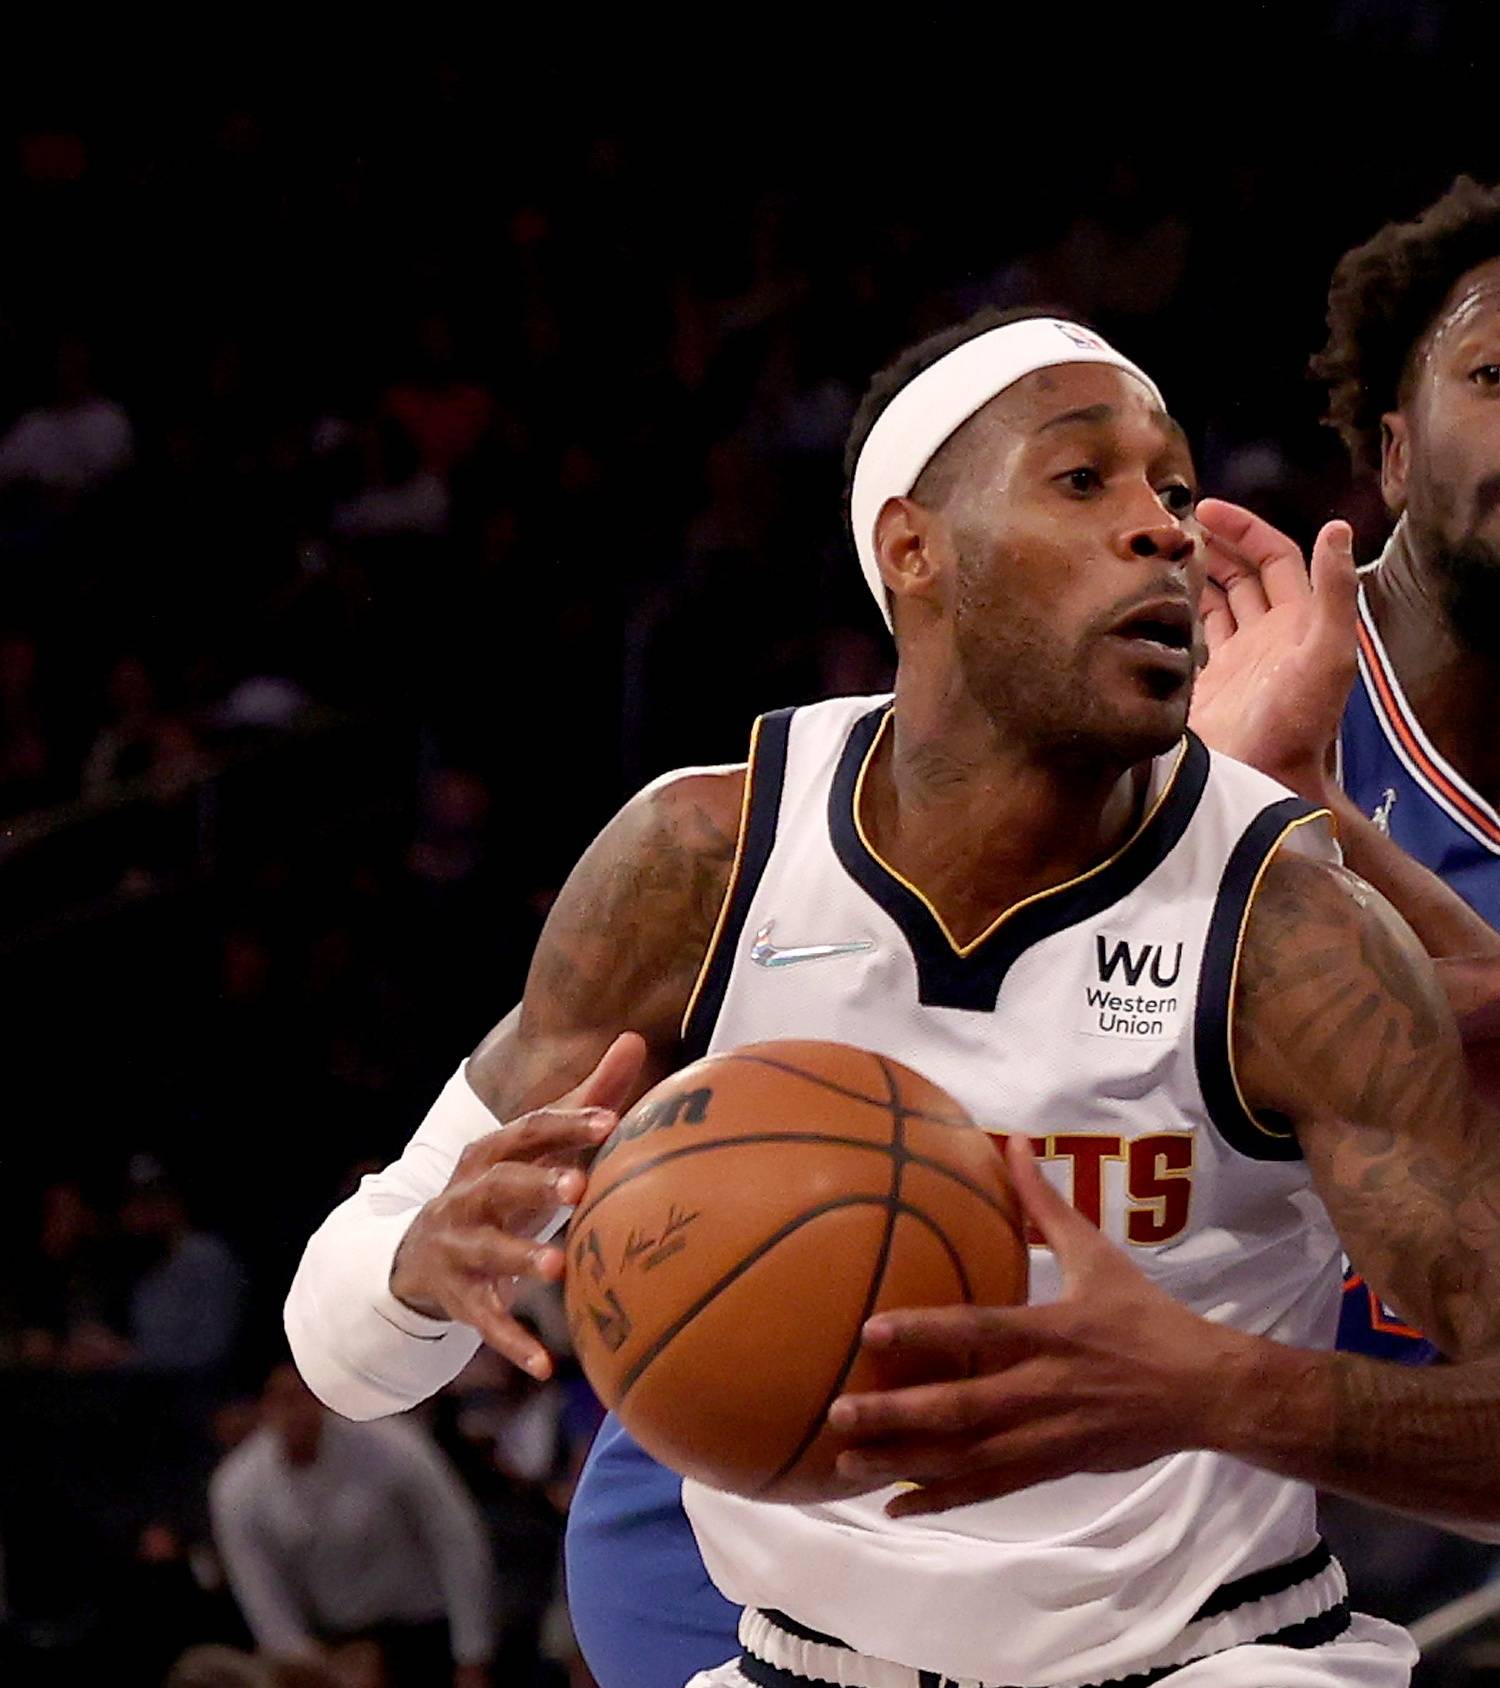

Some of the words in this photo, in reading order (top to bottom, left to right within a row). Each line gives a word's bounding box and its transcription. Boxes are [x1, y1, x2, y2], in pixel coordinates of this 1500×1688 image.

[1096, 934, 1183, 988] WU
[1086, 987, 1177, 1013] Western
[1099, 1012, 1163, 1035] Union
